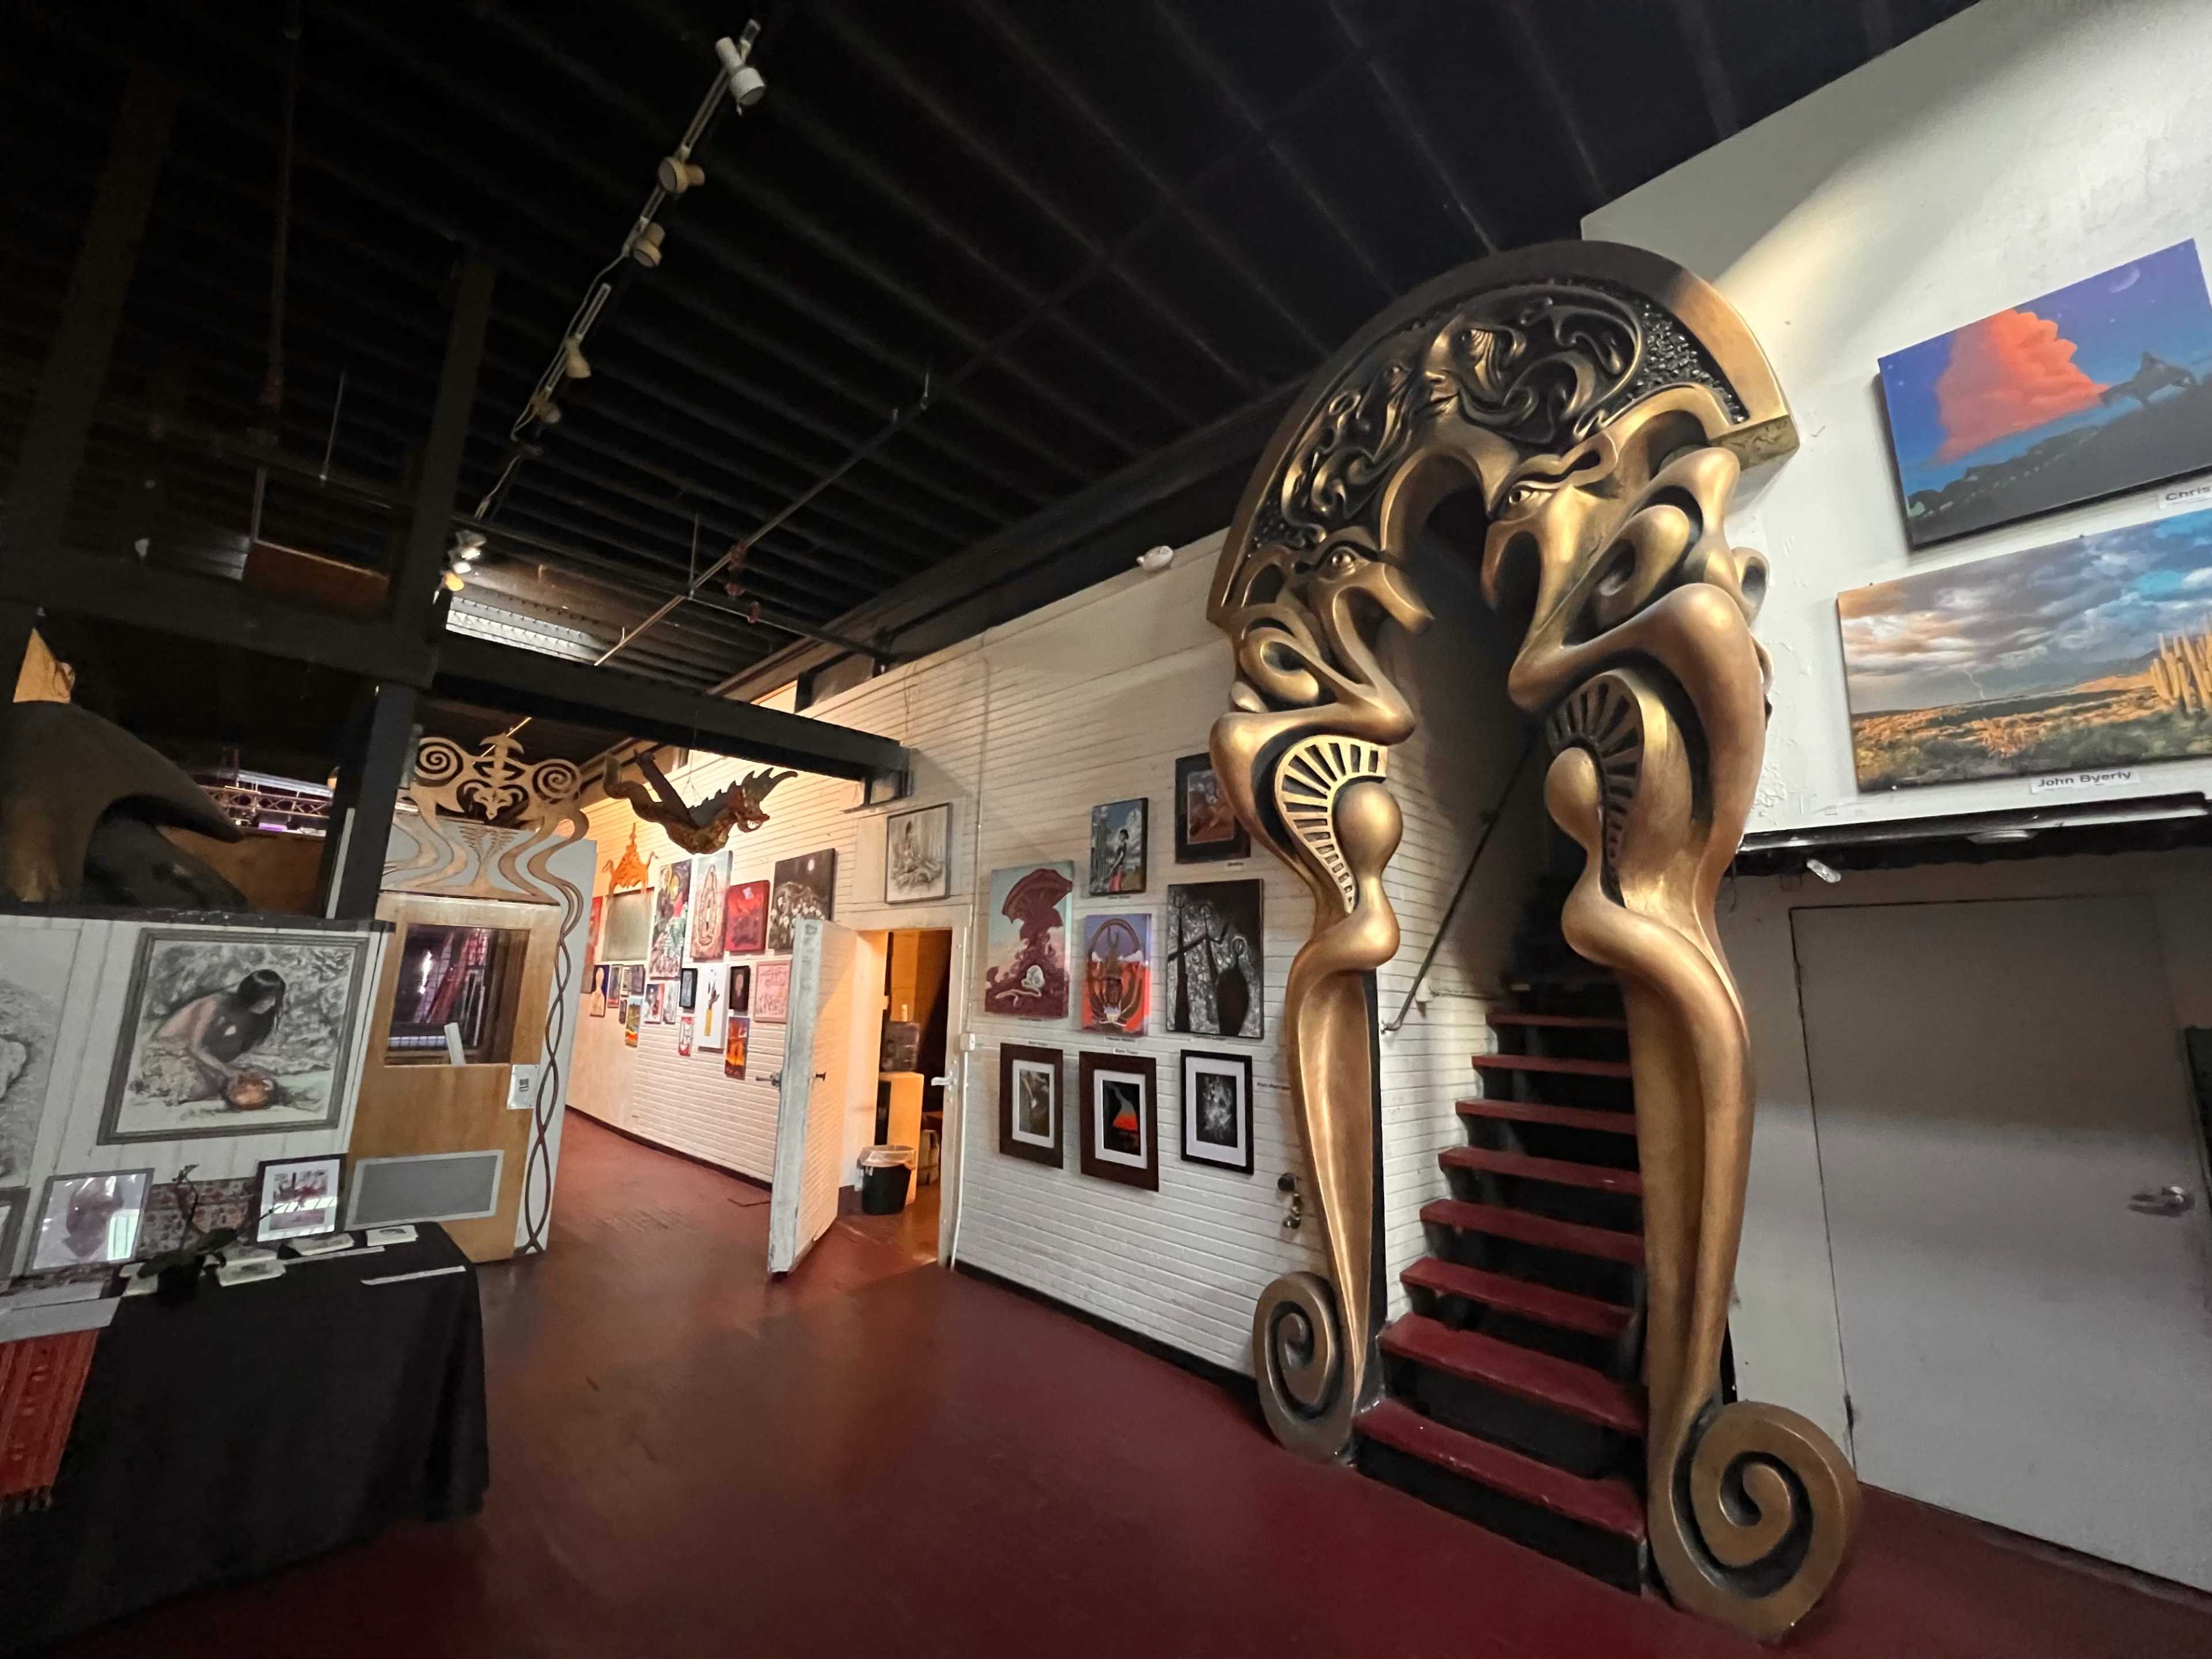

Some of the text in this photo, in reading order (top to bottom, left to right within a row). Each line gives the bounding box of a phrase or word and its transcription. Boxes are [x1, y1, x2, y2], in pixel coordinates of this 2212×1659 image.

[2166, 486, 2211, 501] Chris
[2037, 771, 2131, 787] John Byerly
